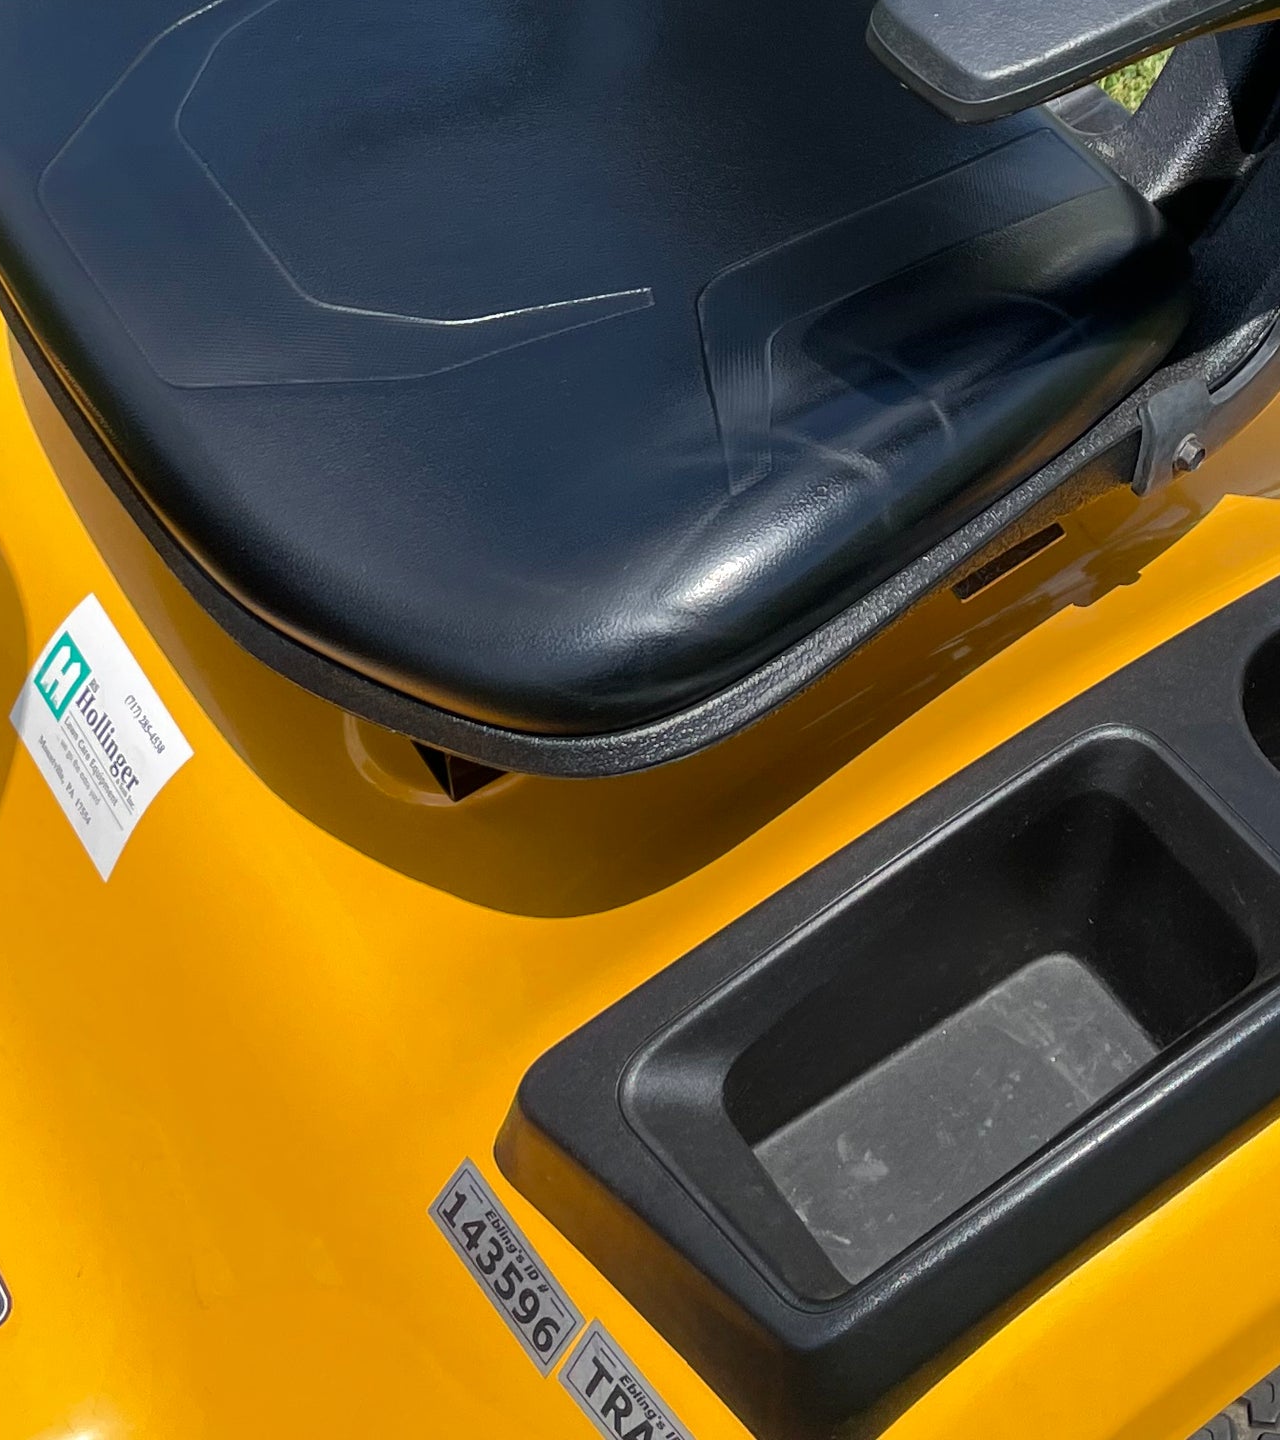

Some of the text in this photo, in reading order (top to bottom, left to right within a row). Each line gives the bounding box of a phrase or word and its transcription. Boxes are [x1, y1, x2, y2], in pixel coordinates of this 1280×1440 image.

[75, 685, 140, 793] Hollinger
[123, 692, 142, 721] (717)
[63, 715, 119, 807] Lawn Care Equipment
[64, 781, 76, 799] PA
[440, 1186, 563, 1357] 143596
[482, 1206, 548, 1296] Ebling's ID #
[617, 1370, 667, 1433] Ebling's
